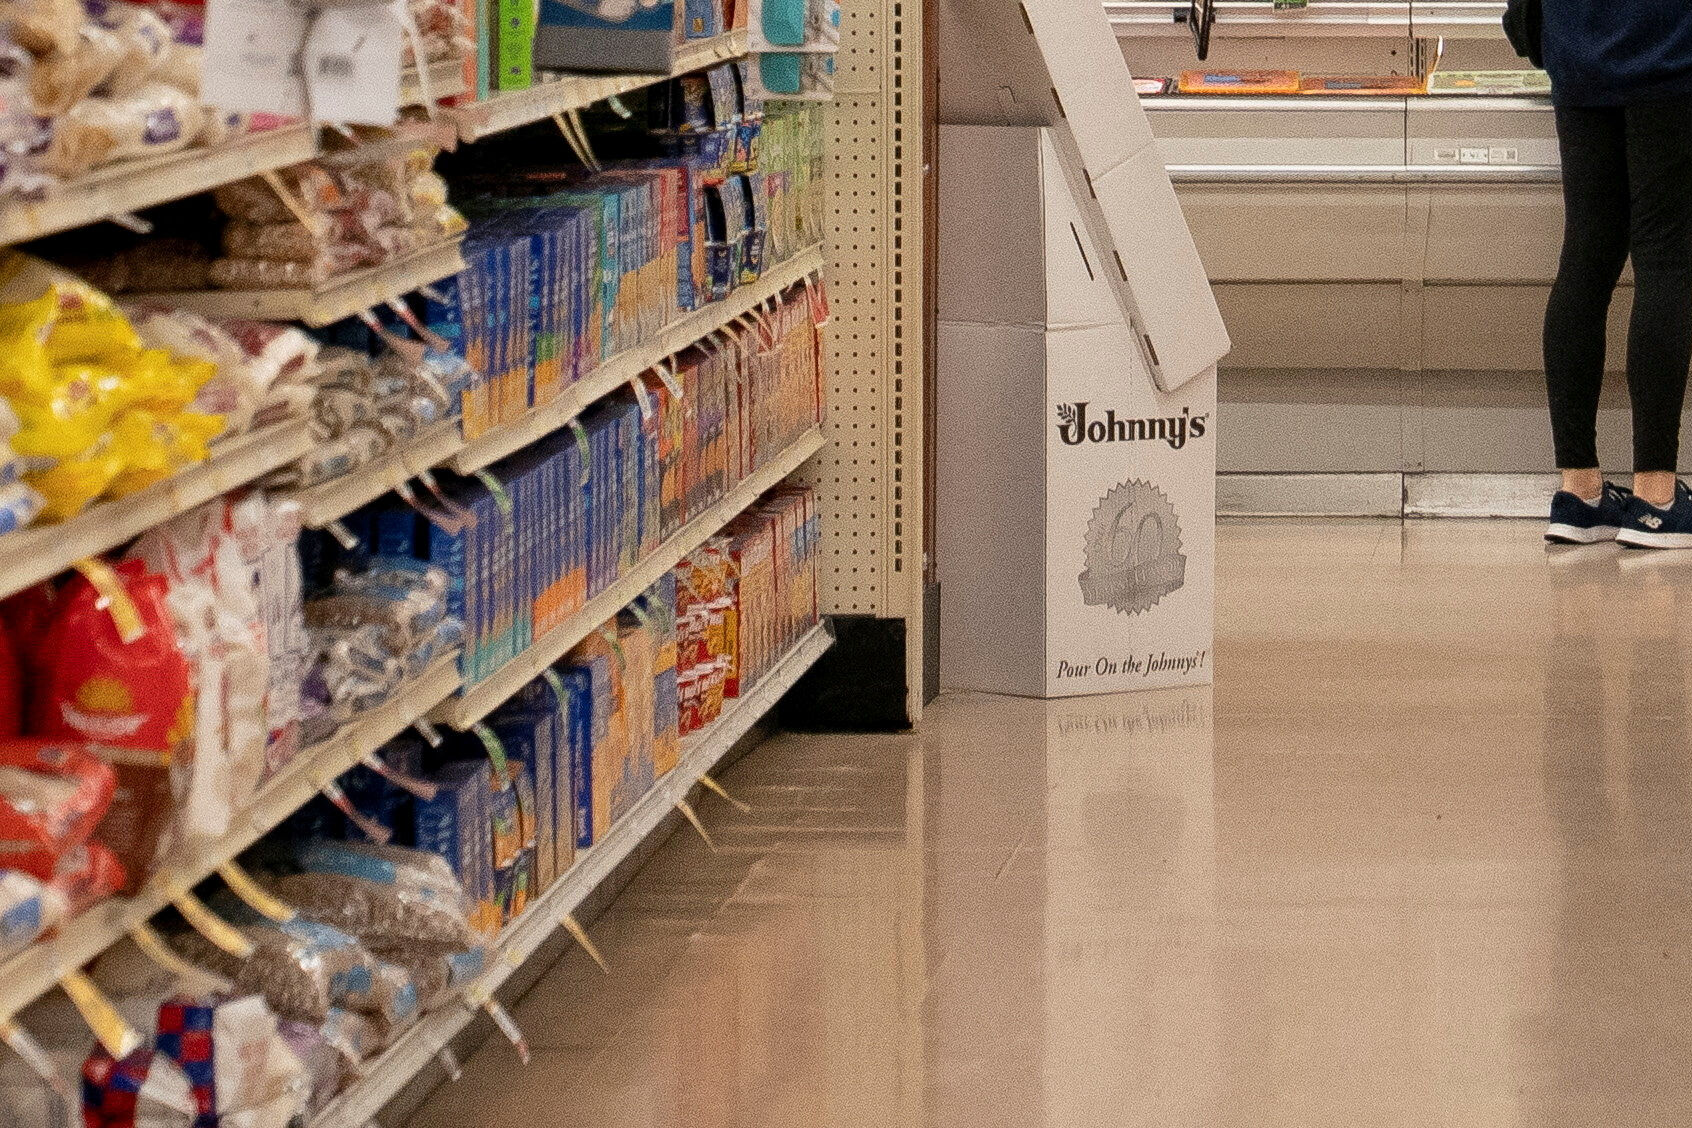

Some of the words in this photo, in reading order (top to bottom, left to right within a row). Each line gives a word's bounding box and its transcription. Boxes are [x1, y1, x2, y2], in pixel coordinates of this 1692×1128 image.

[1056, 401, 1207, 450] Johnny's
[1056, 659, 1091, 678] Pour
[1095, 656, 1117, 675] On
[1122, 654, 1143, 675] the
